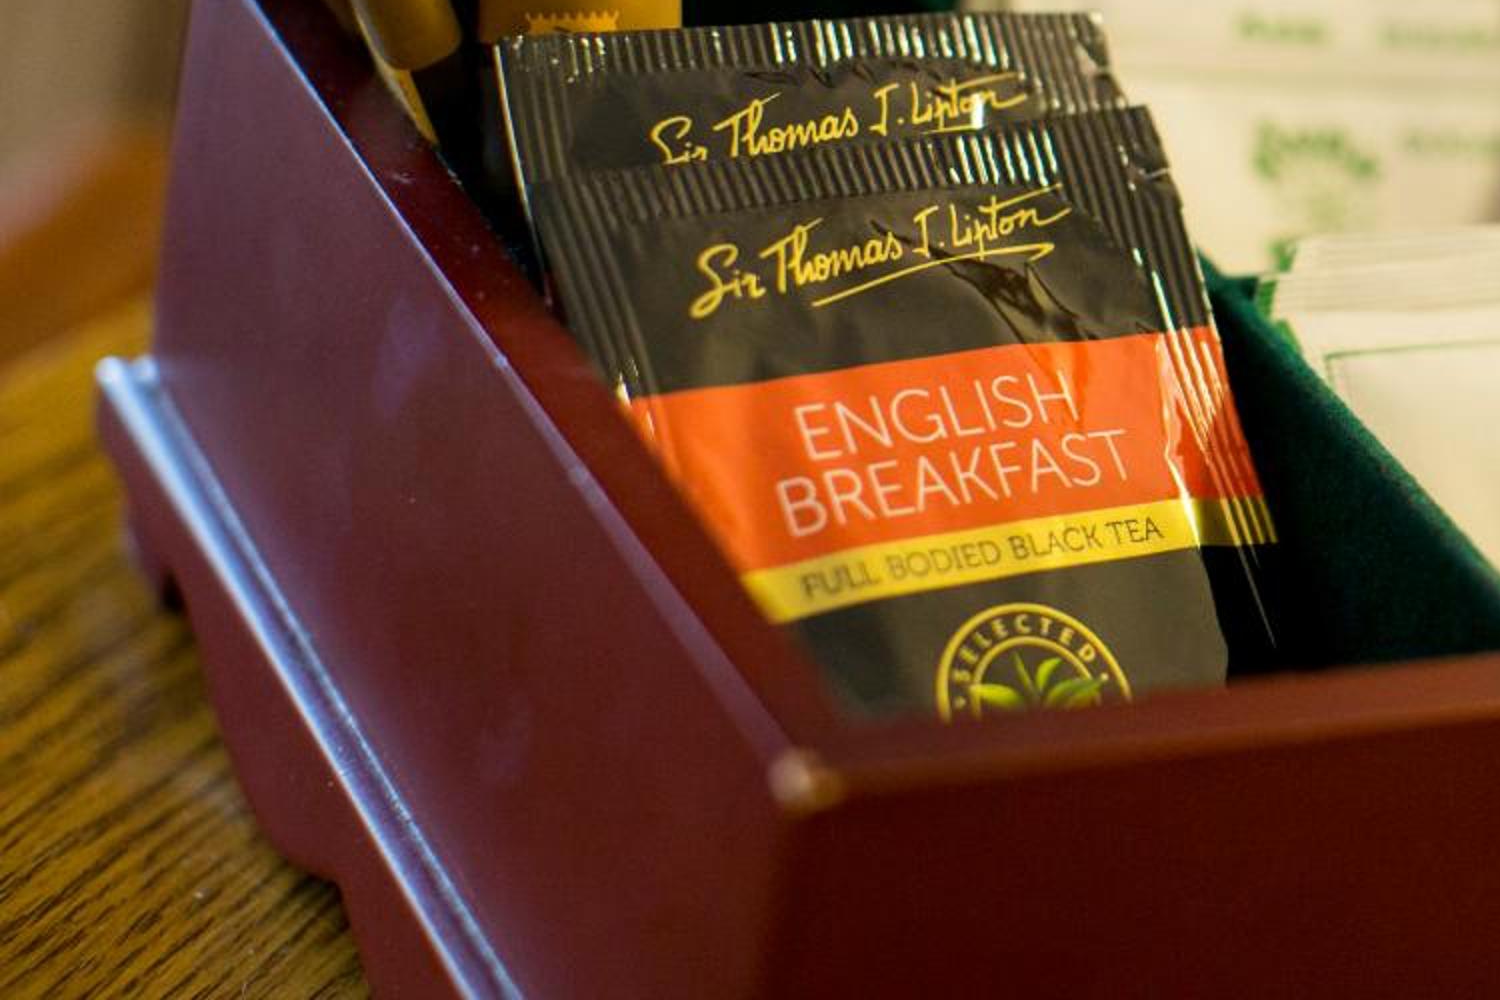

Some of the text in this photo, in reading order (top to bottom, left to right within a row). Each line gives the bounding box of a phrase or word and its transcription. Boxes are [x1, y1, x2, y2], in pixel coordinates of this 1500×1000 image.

[650, 115, 708, 165] Sir
[712, 91, 860, 158] Thomas
[910, 72, 1028, 134] Lipton
[689, 242, 766, 319] Sir
[759, 217, 904, 294] Thomas
[949, 182, 1073, 261] Lipton
[793, 370, 1080, 462] ENGLISH
[775, 428, 1128, 538] BREAKFAST
[801, 516, 1165, 599] FULL BODIED BLACK TEA
[953, 613, 1097, 685] SELECTED
